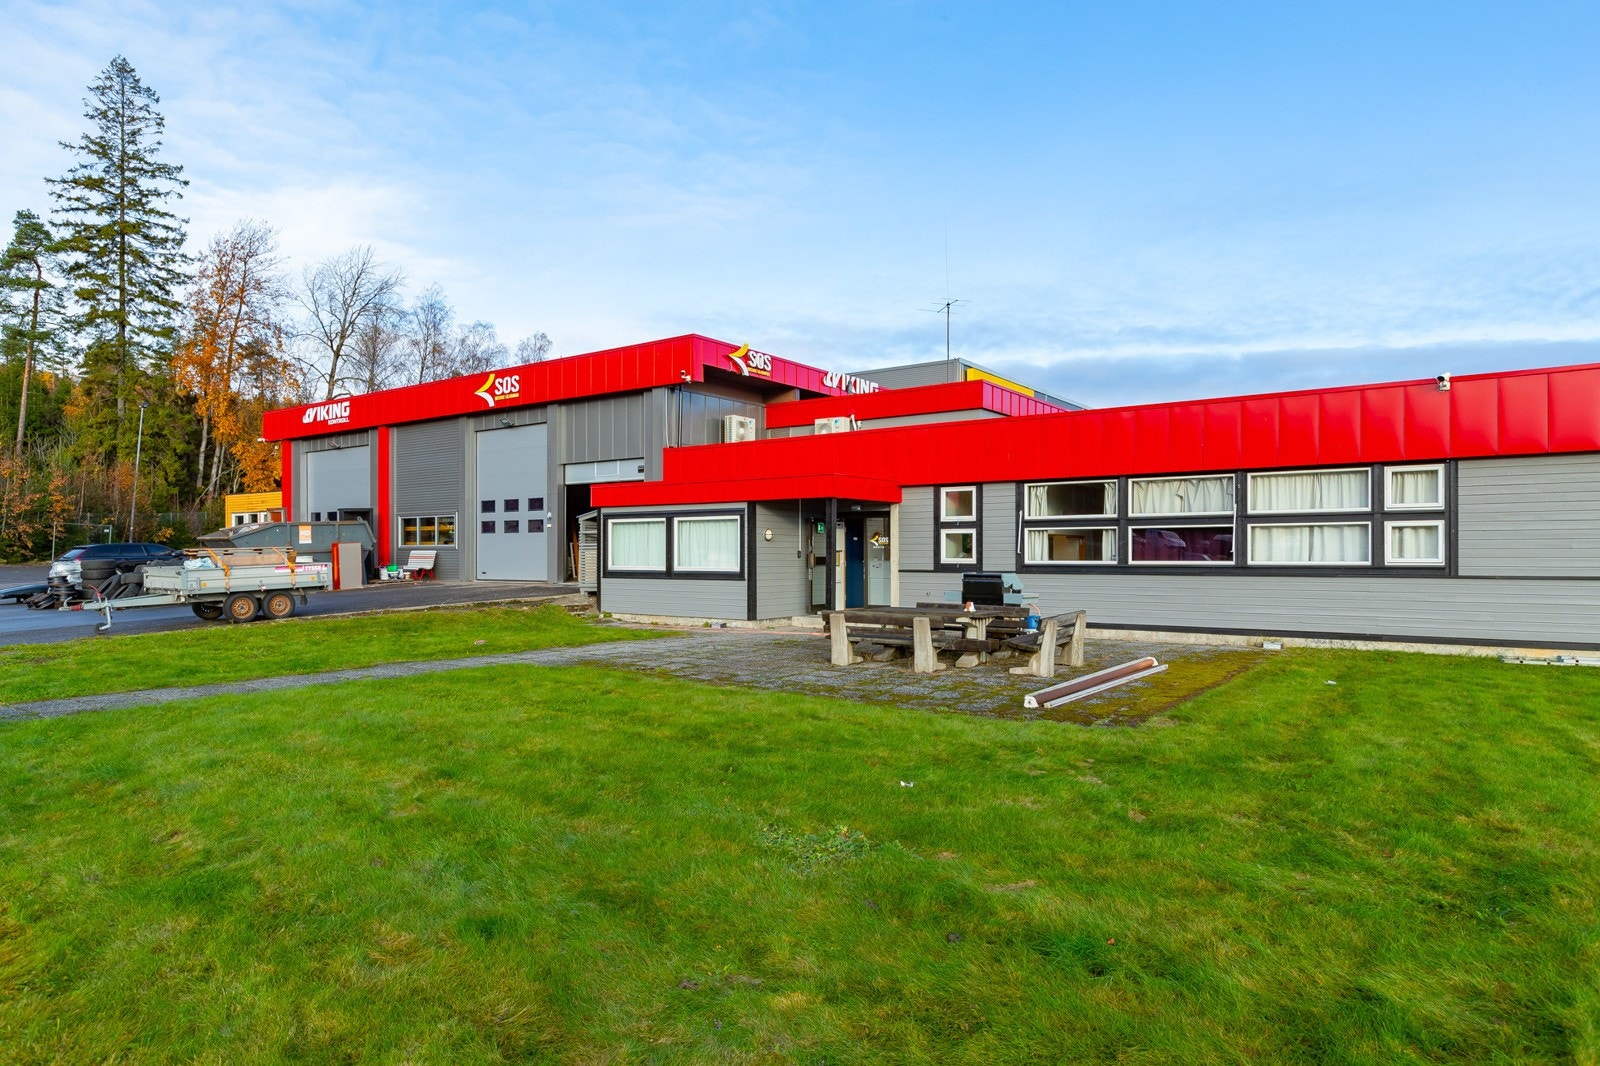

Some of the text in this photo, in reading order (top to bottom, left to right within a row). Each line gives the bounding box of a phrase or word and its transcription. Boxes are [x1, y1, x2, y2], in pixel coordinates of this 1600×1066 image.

[748, 350, 772, 371] SOS
[494, 375, 520, 395] SOS
[302, 401, 350, 424] VIKING
